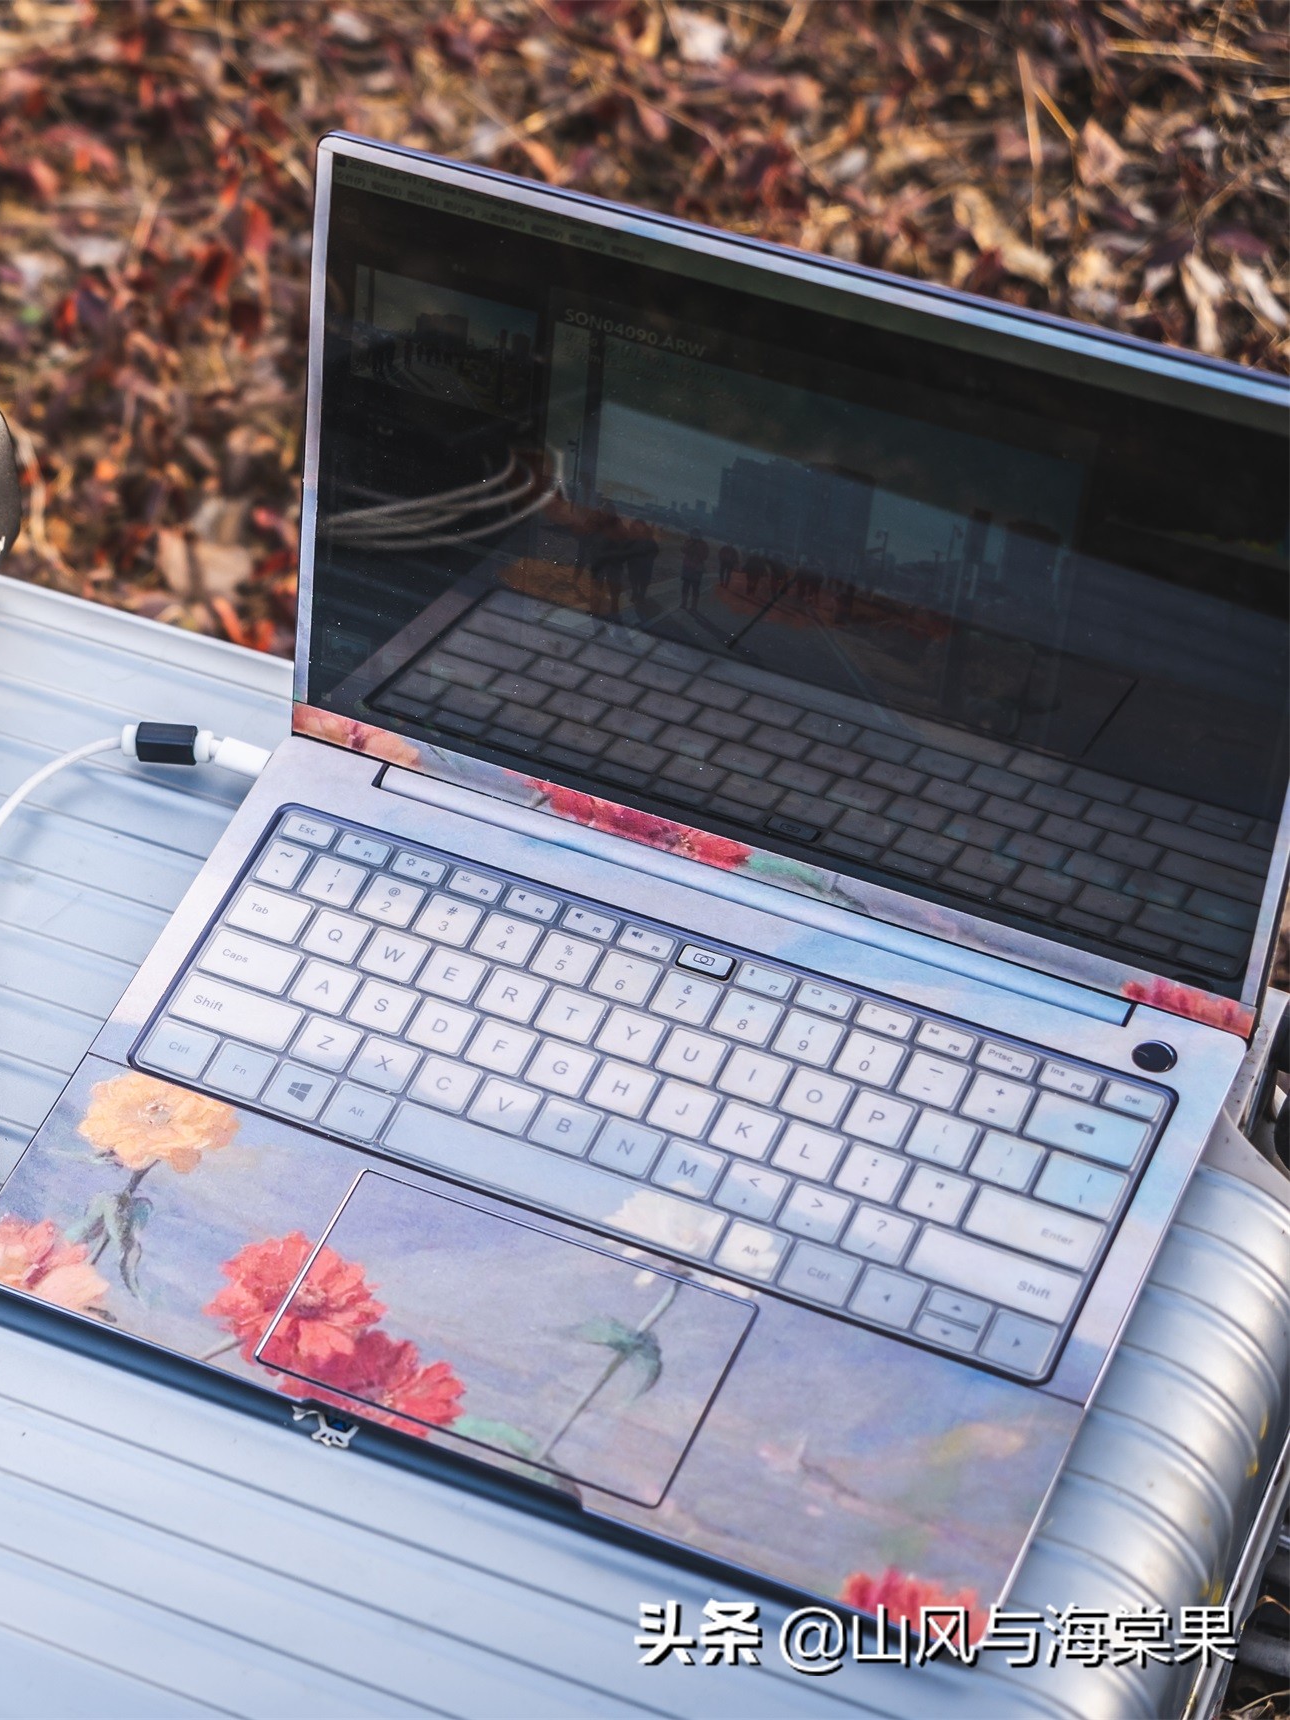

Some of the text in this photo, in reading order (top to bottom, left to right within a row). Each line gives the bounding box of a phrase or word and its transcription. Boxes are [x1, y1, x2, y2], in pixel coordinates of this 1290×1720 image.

[298, 824, 316, 836] Esc
[327, 883, 333, 892] 1
[388, 887, 401, 897] @
[252, 903, 268, 914] Tab
[380, 902, 391, 912] 2
[447, 907, 458, 915] #
[438, 921, 449, 931] 3
[506, 926, 514, 934] $
[328, 929, 342, 943] Q
[497, 940, 507, 950] 4
[564, 945, 574, 956] %
[223, 949, 248, 963] Caps
[384, 946, 405, 962] W
[555, 960, 566, 970] 5
[442, 967, 459, 981] E
[315, 980, 329, 994] A
[615, 980, 625, 990] 6
[683, 985, 692, 994] &
[502, 987, 518, 1002] R
[194, 995, 223, 1011] Shift
[374, 999, 389, 1012] S
[676, 999, 687, 1009] 7
[566, 1007, 579, 1020] T
[431, 1018, 448, 1033] D
[737, 1019, 748, 1030] 8
[627, 1026, 641, 1040] Y
[169, 1042, 190, 1054] Ctrl
[317, 1035, 334, 1050] Z
[492, 1040, 508, 1052] F
[798, 1040, 808, 1051] 9
[683, 1047, 699, 1062] U
[375, 1055, 393, 1071] X
[552, 1061, 569, 1074] G
[859, 1060, 870, 1071] 0
[232, 1065, 246, 1075] Fn
[748, 1069, 756, 1082] I
[1051, 1067, 1065, 1076] Ins
[436, 1077, 452, 1090] C
[612, 1080, 630, 1096] H
[806, 1089, 823, 1103] O
[1125, 1095, 1140, 1104] Del
[499, 1097, 513, 1112] V
[675, 1104, 689, 1116] J
[348, 1107, 364, 1117] Alt
[868, 1110, 885, 1123] P
[556, 1118, 572, 1133] B
[735, 1122, 752, 1138] K
[617, 1139, 635, 1155] N
[799, 1144, 809, 1159] L
[677, 1160, 698, 1177] M
[877, 1220, 887, 1232] ?
[1041, 1228, 1073, 1245] Enter
[742, 1246, 759, 1257] Alt
[807, 1267, 831, 1281] Ctrl
[1017, 1281, 1050, 1299] Shift
